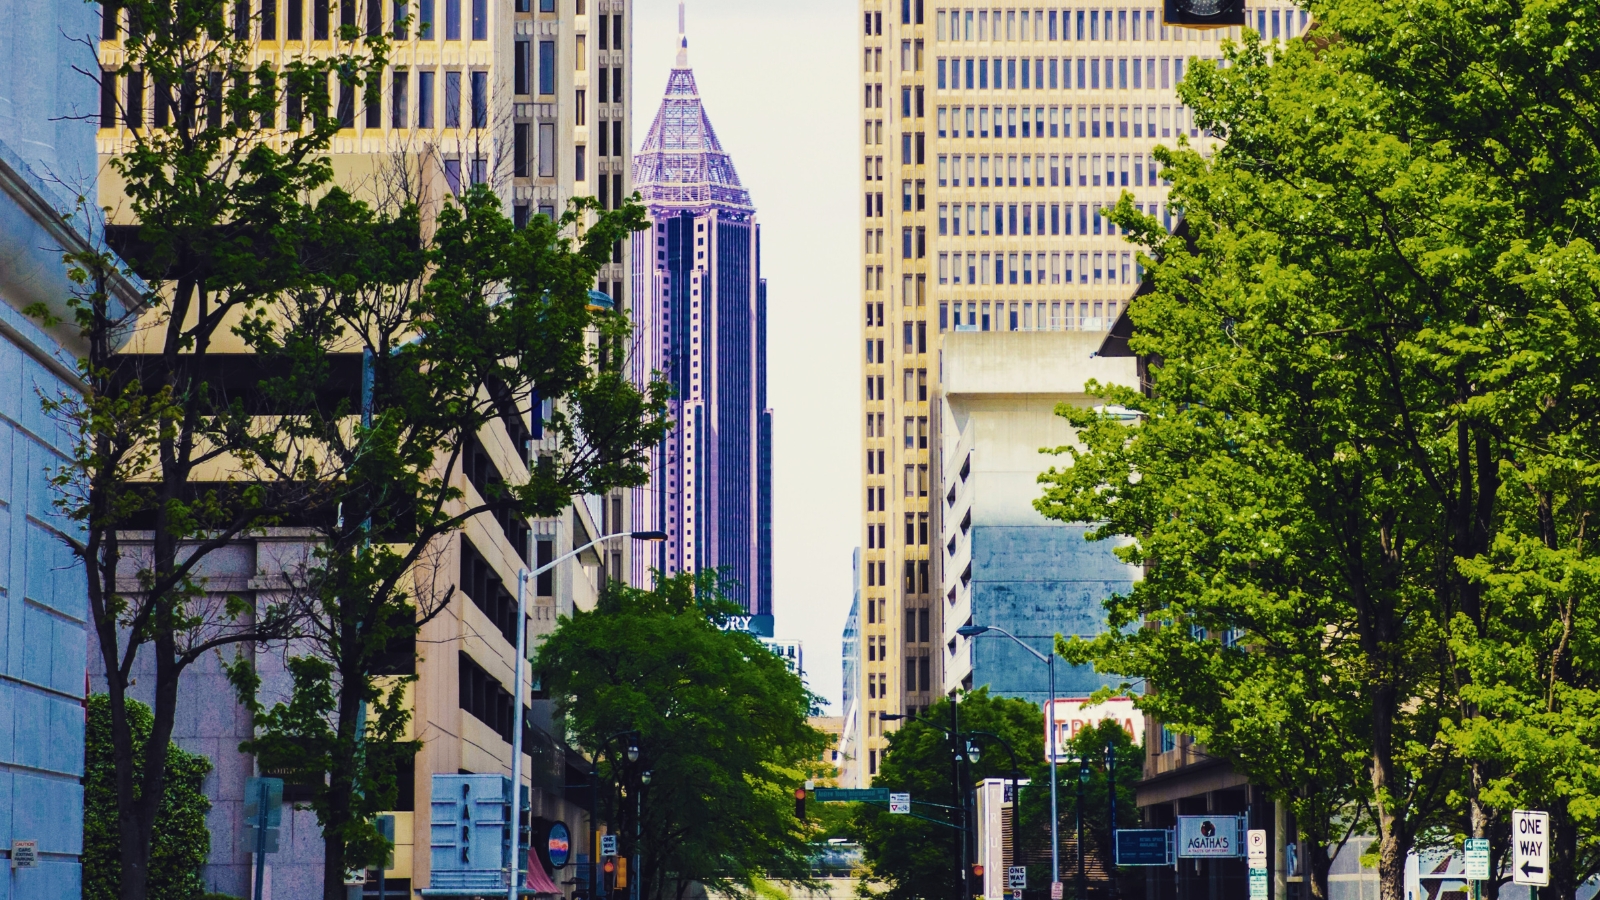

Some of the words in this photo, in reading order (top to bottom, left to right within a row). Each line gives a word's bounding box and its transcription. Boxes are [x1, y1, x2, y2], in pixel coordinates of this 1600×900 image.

[462, 783, 471, 864] PARK
[1519, 818, 1542, 835] ONE
[990, 788, 1000, 897] TRUVA
[1187, 837, 1229, 849] AGATHA'S
[1466, 840, 1473, 849] 4
[1519, 840, 1543, 857] WAY
